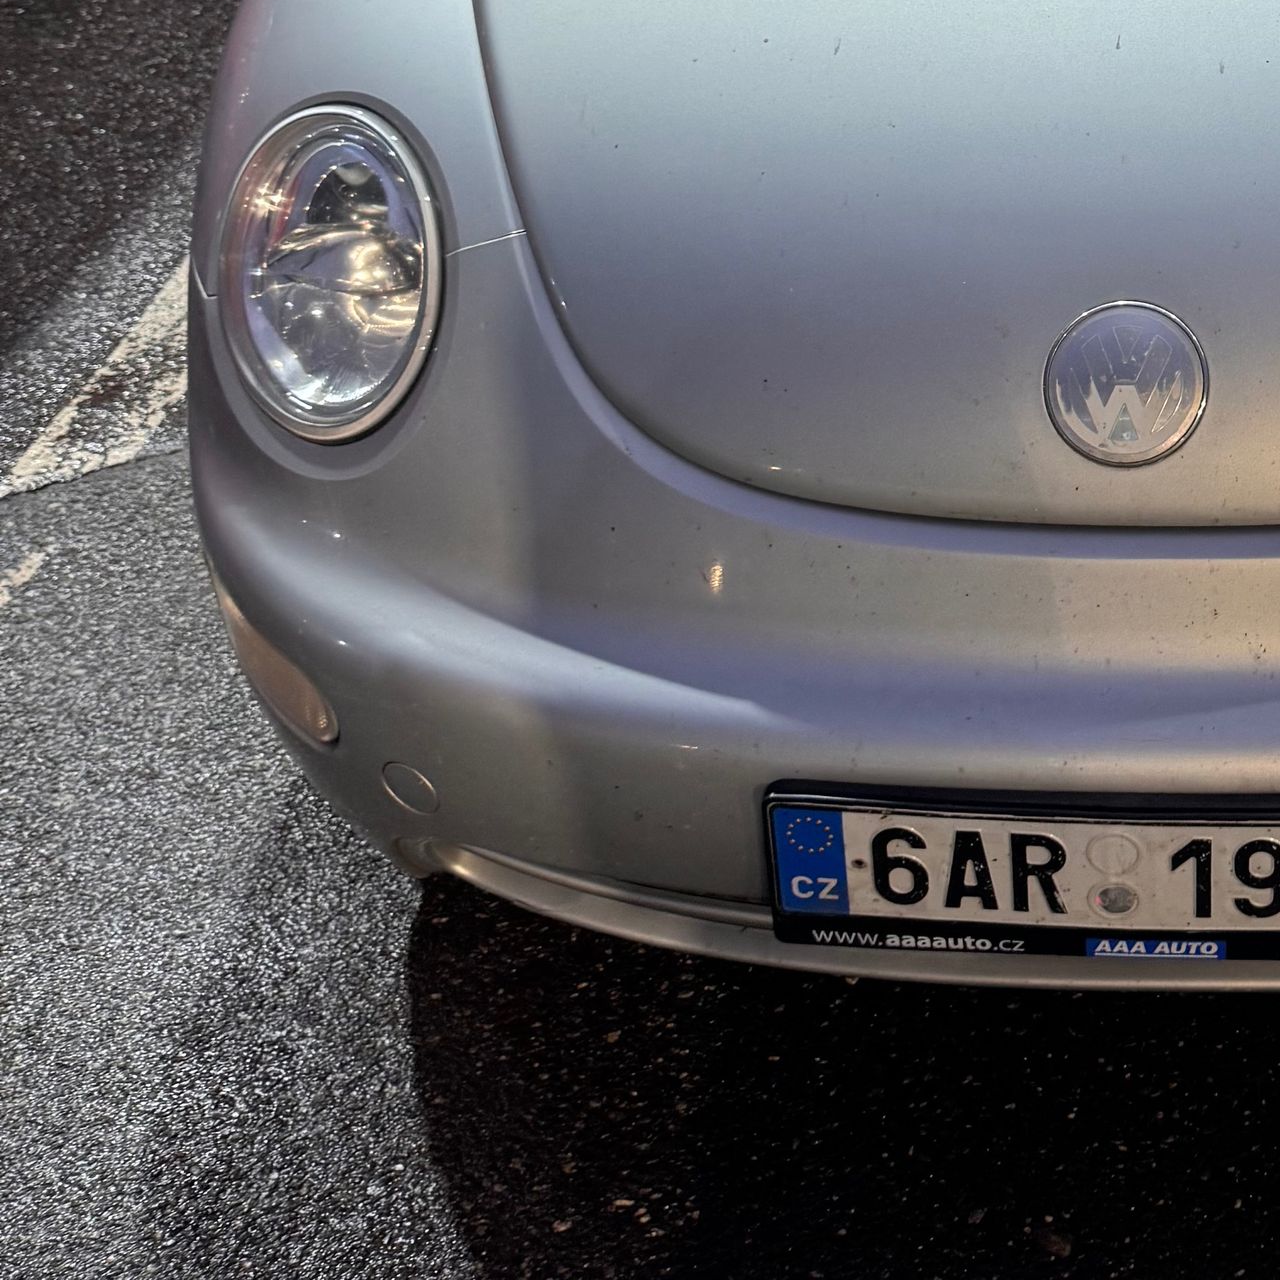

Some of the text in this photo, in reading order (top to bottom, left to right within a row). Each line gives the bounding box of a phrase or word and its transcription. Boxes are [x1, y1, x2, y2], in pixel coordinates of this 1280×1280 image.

[871, 827, 1069, 915] 6AR
[790, 875, 840, 901] CZ
[812, 928, 1025, 953] www.aaaauto.cz
[1094, 939, 1219, 955] AAA AUTO
